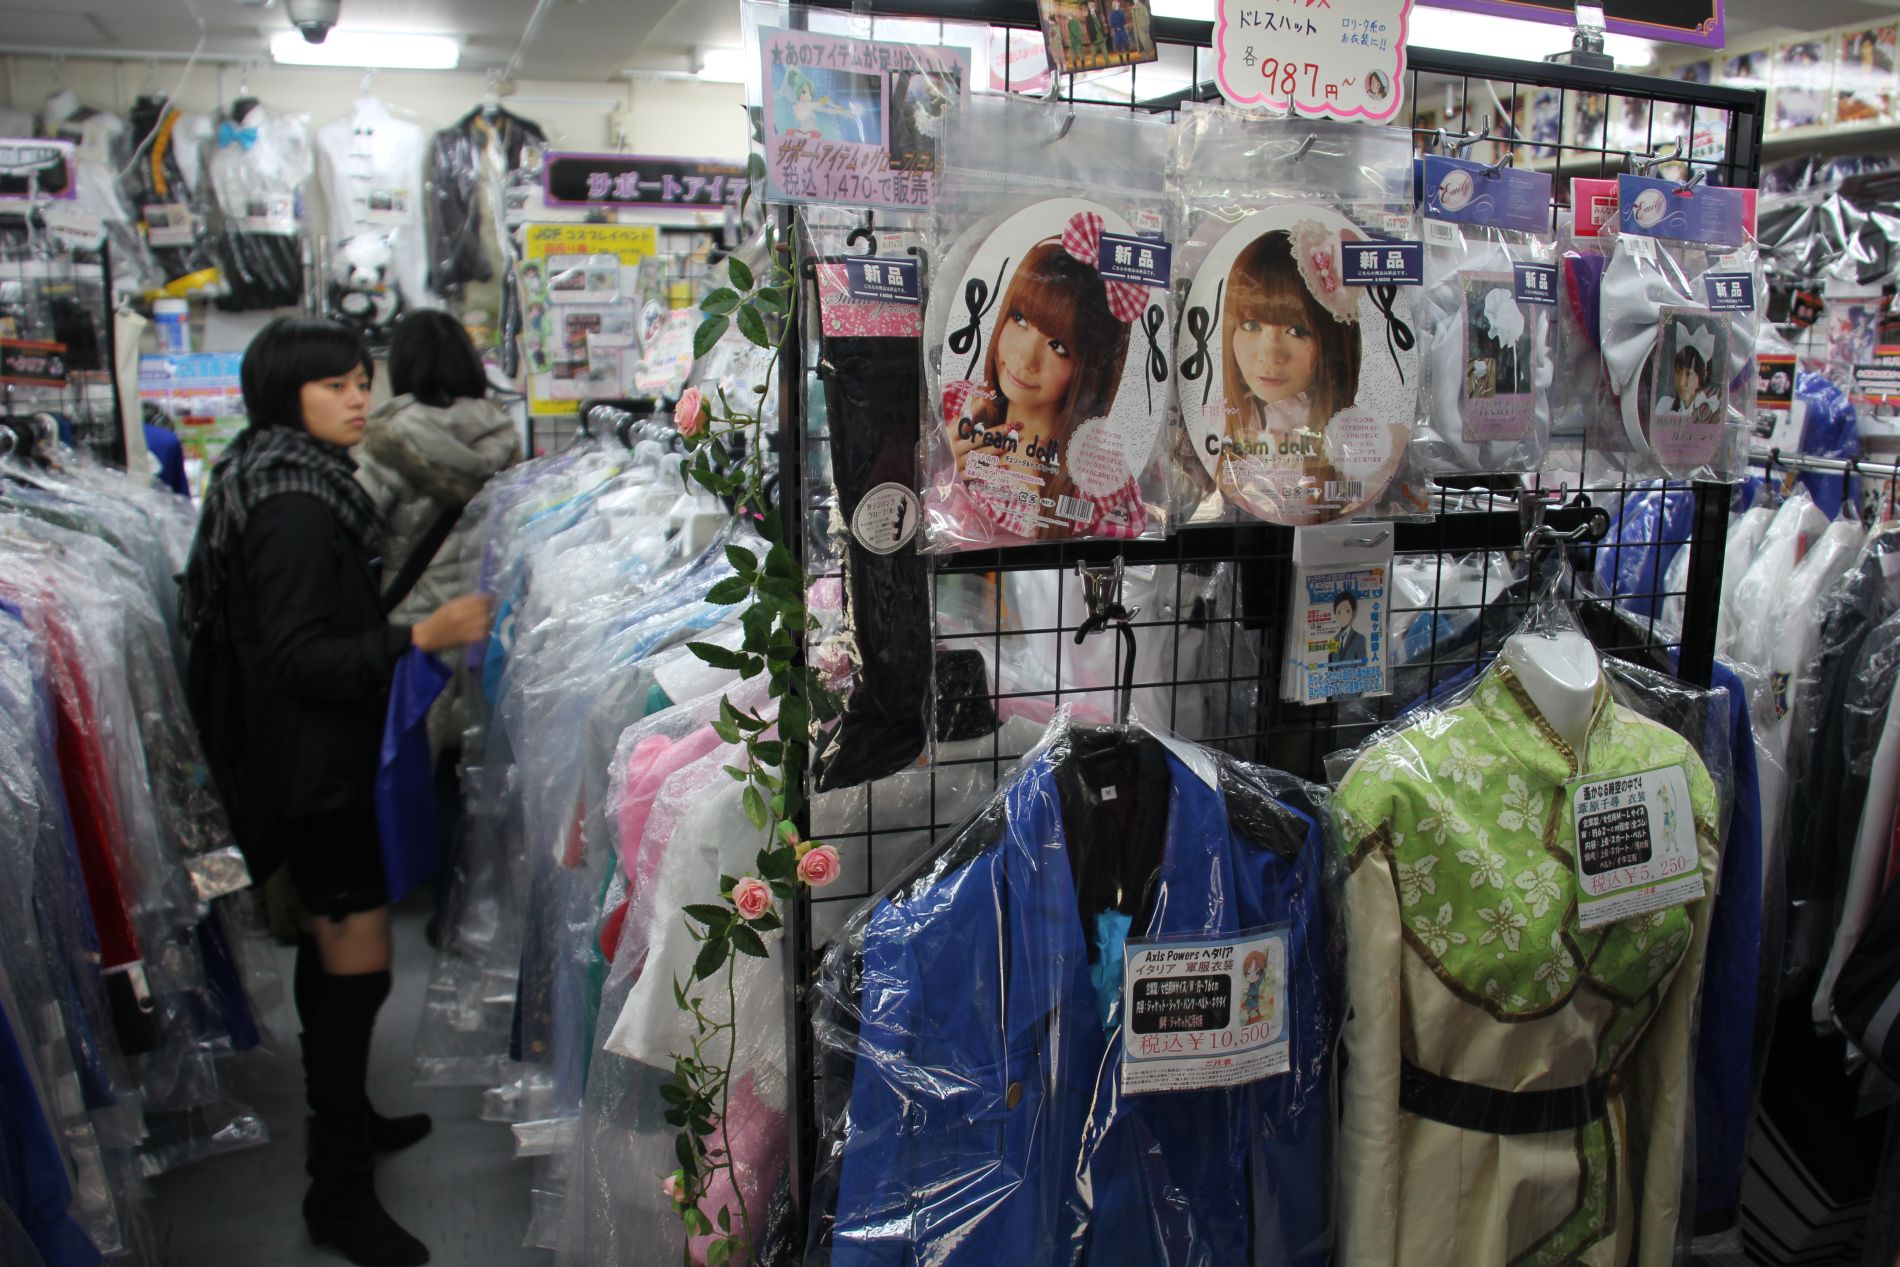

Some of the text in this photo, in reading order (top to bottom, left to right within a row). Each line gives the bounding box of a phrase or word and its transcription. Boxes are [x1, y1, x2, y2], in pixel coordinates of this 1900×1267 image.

[1240, 10, 1317, 35] ドレスハット
[1341, 18, 1386, 33] ロリータ系の
[1242, 46, 1258, 66] 各
[1441, 182, 1471, 204] Emily
[1636, 197, 1666, 220] Emily
[1115, 245, 1154, 269] 新品
[1360, 251, 1405, 269] 新品
[863, 264, 904, 286] 新品
[1525, 271, 1548, 290] 新品
[1715, 281, 1742, 298] 新品
[958, 417, 1018, 453] Cream
[1026, 434, 1059, 465] doll
[1205, 433, 1269, 456] Cream
[1628, 791, 1646, 805] 衣装
[1146, 947, 1233, 962] Axis Powers ヘタリア
[1136, 960, 1234, 975] イタリア 軍服衣装
